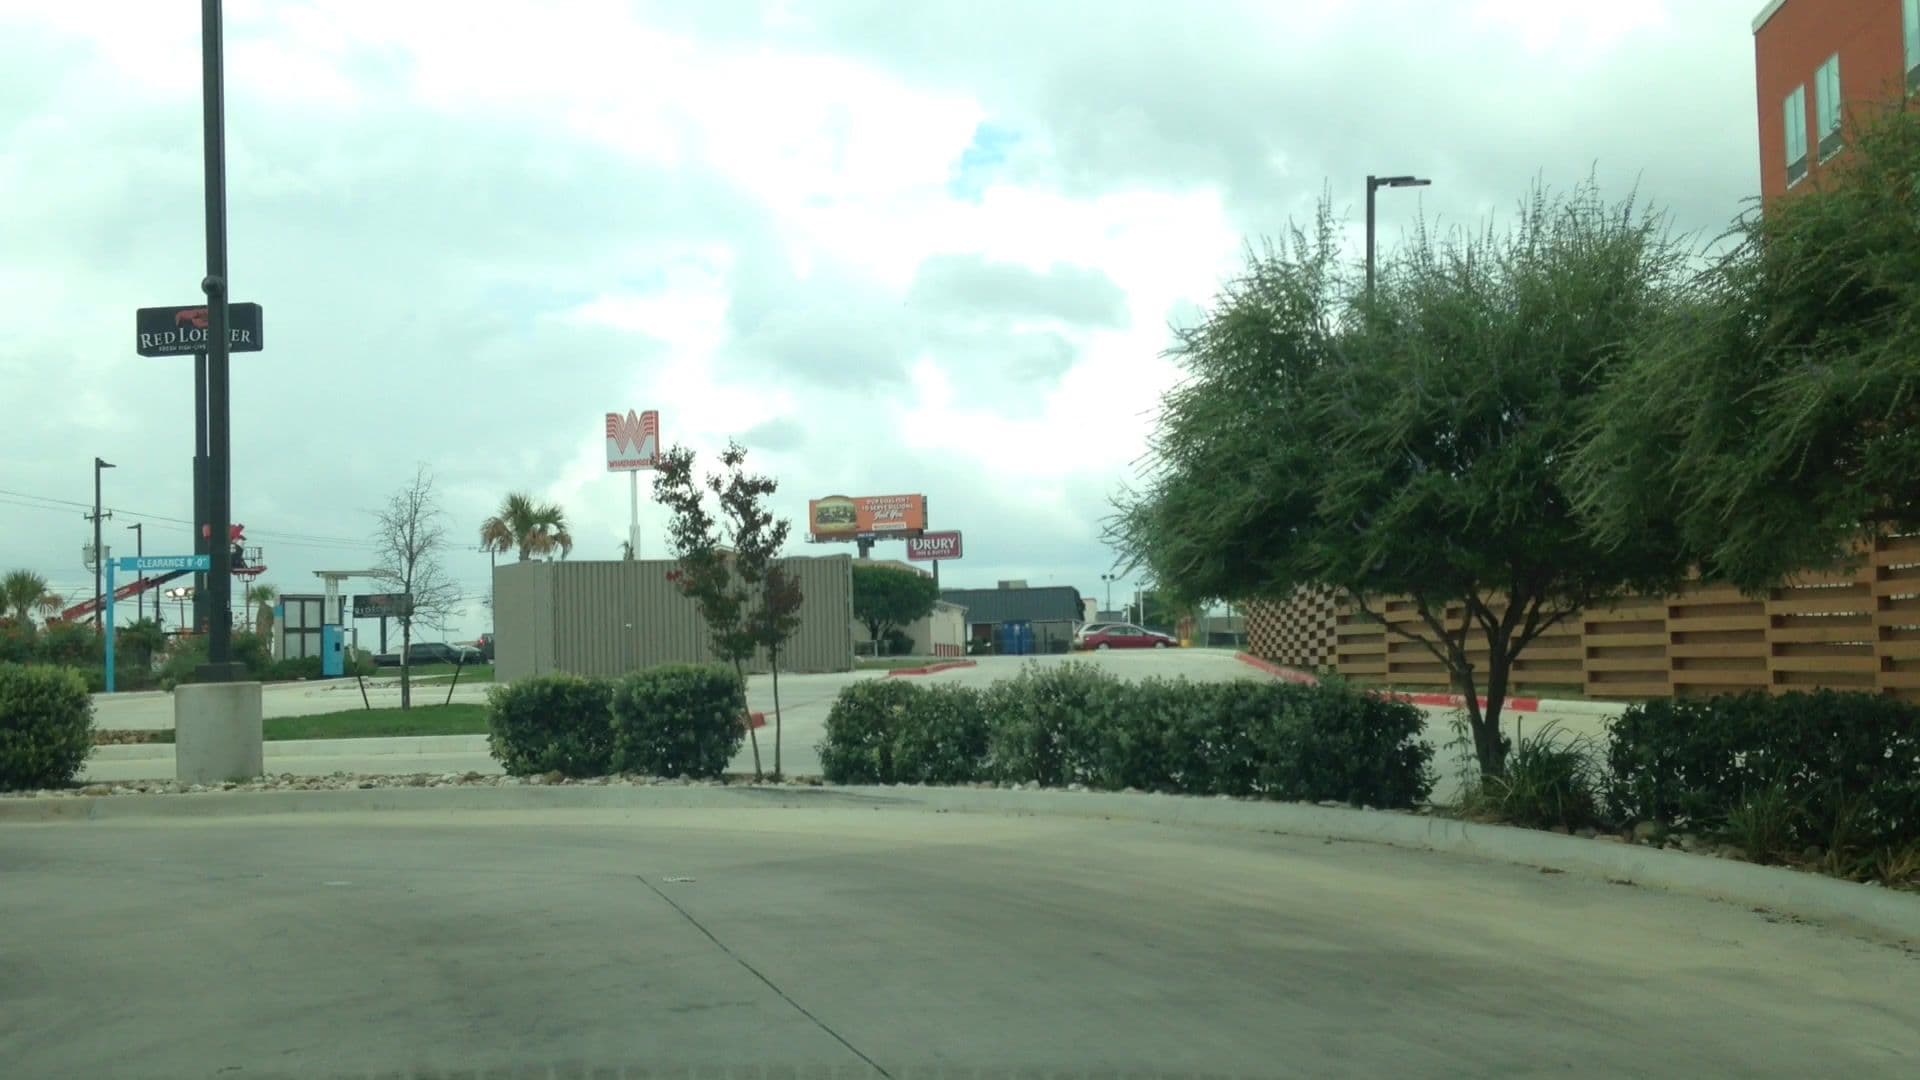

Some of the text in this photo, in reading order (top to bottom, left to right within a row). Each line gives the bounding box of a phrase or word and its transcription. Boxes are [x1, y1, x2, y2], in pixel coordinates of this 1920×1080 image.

[140, 327, 250, 348] RED LOBER
[910, 537, 956, 550] DRURY
[137, 558, 185, 568] CLEARANCE
